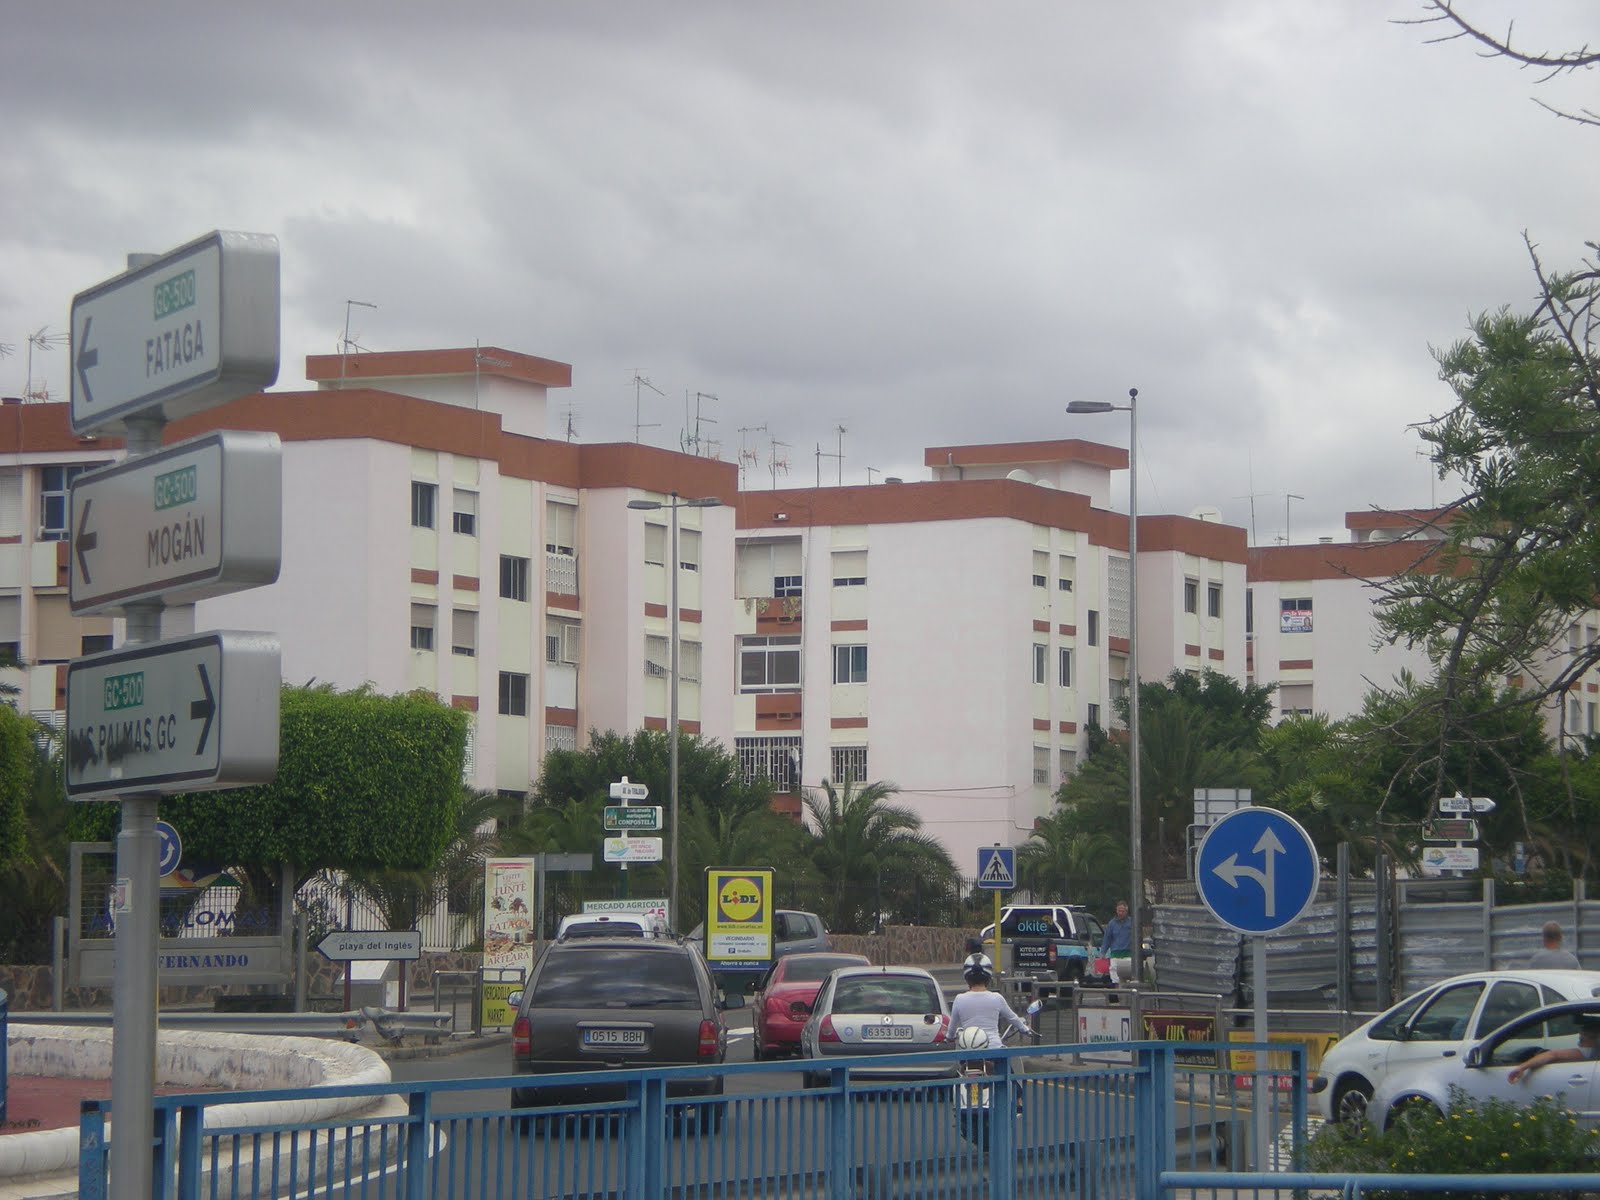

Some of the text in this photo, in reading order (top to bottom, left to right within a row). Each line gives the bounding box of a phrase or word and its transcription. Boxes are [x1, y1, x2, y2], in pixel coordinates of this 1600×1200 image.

[155, 274, 195, 315] GC-500
[146, 320, 203, 377] FATAGA
[156, 468, 196, 508] GC-500
[148, 511, 205, 568] MOGÁN
[105, 676, 143, 708] GC-500
[157, 714, 177, 750] GC
[494, 884, 527, 896] TUNTE
[626, 901, 666, 909] AGRICOLA
[1018, 920, 1048, 931] okite
[339, 942, 364, 951] playa
[366, 942, 381, 950] del
[487, 952, 530, 966] ARTEARA
[592, 1031, 642, 1042] 0515 BBH
[868, 1026, 891, 1036] 6353
